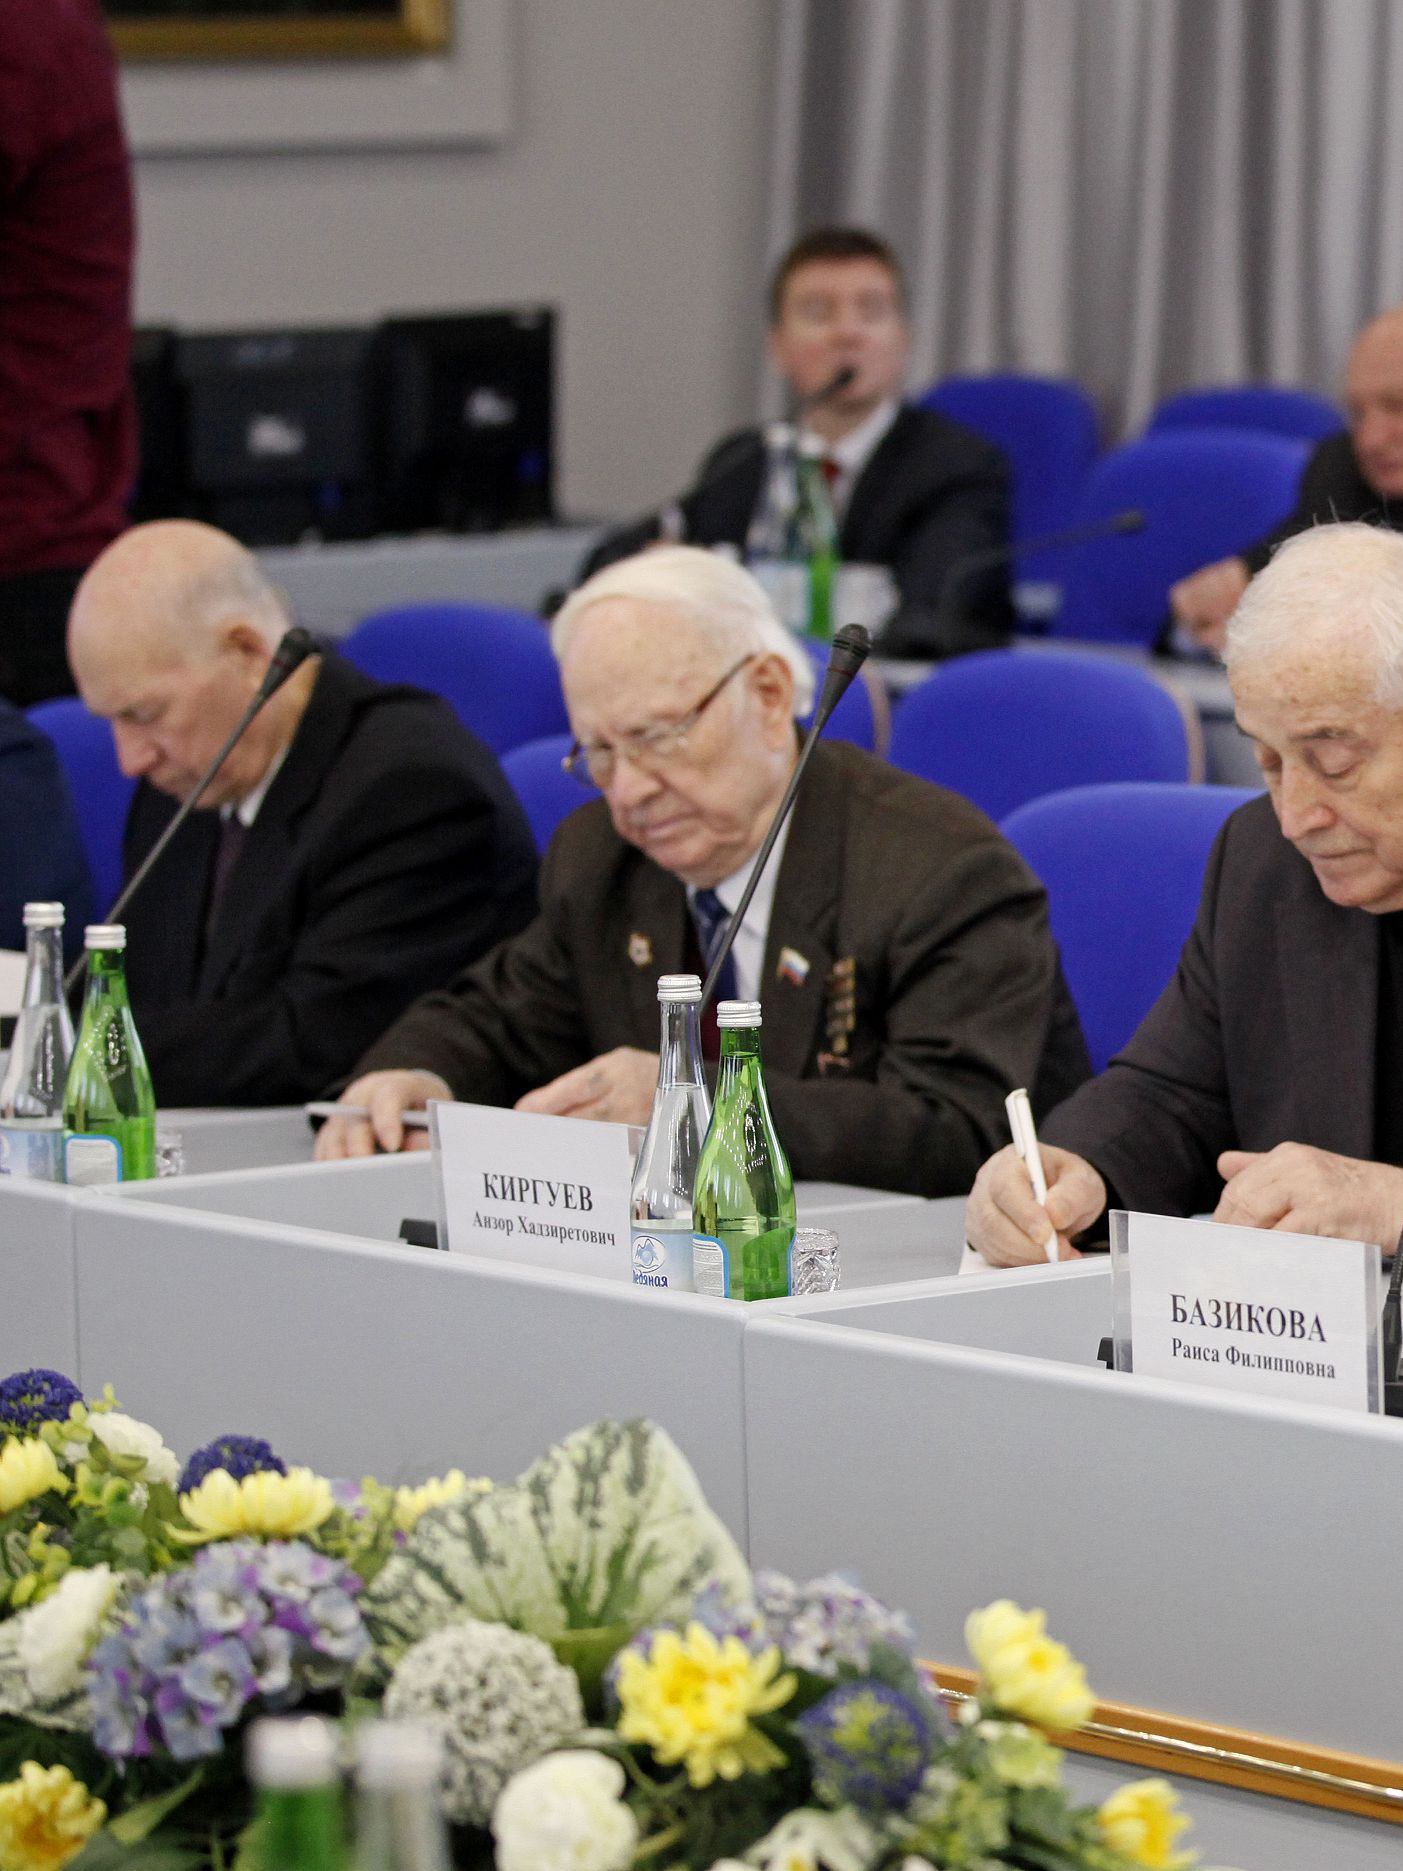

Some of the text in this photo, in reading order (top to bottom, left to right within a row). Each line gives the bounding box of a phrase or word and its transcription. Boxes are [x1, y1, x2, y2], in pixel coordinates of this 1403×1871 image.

[482, 1172, 593, 1211] КИРГУЕВ
[472, 1210, 616, 1246] Анзор Хадзиретович
[1170, 1294, 1327, 1343] БАЗИКОВА
[1171, 1337, 1336, 1380] Раиса Филипповна
